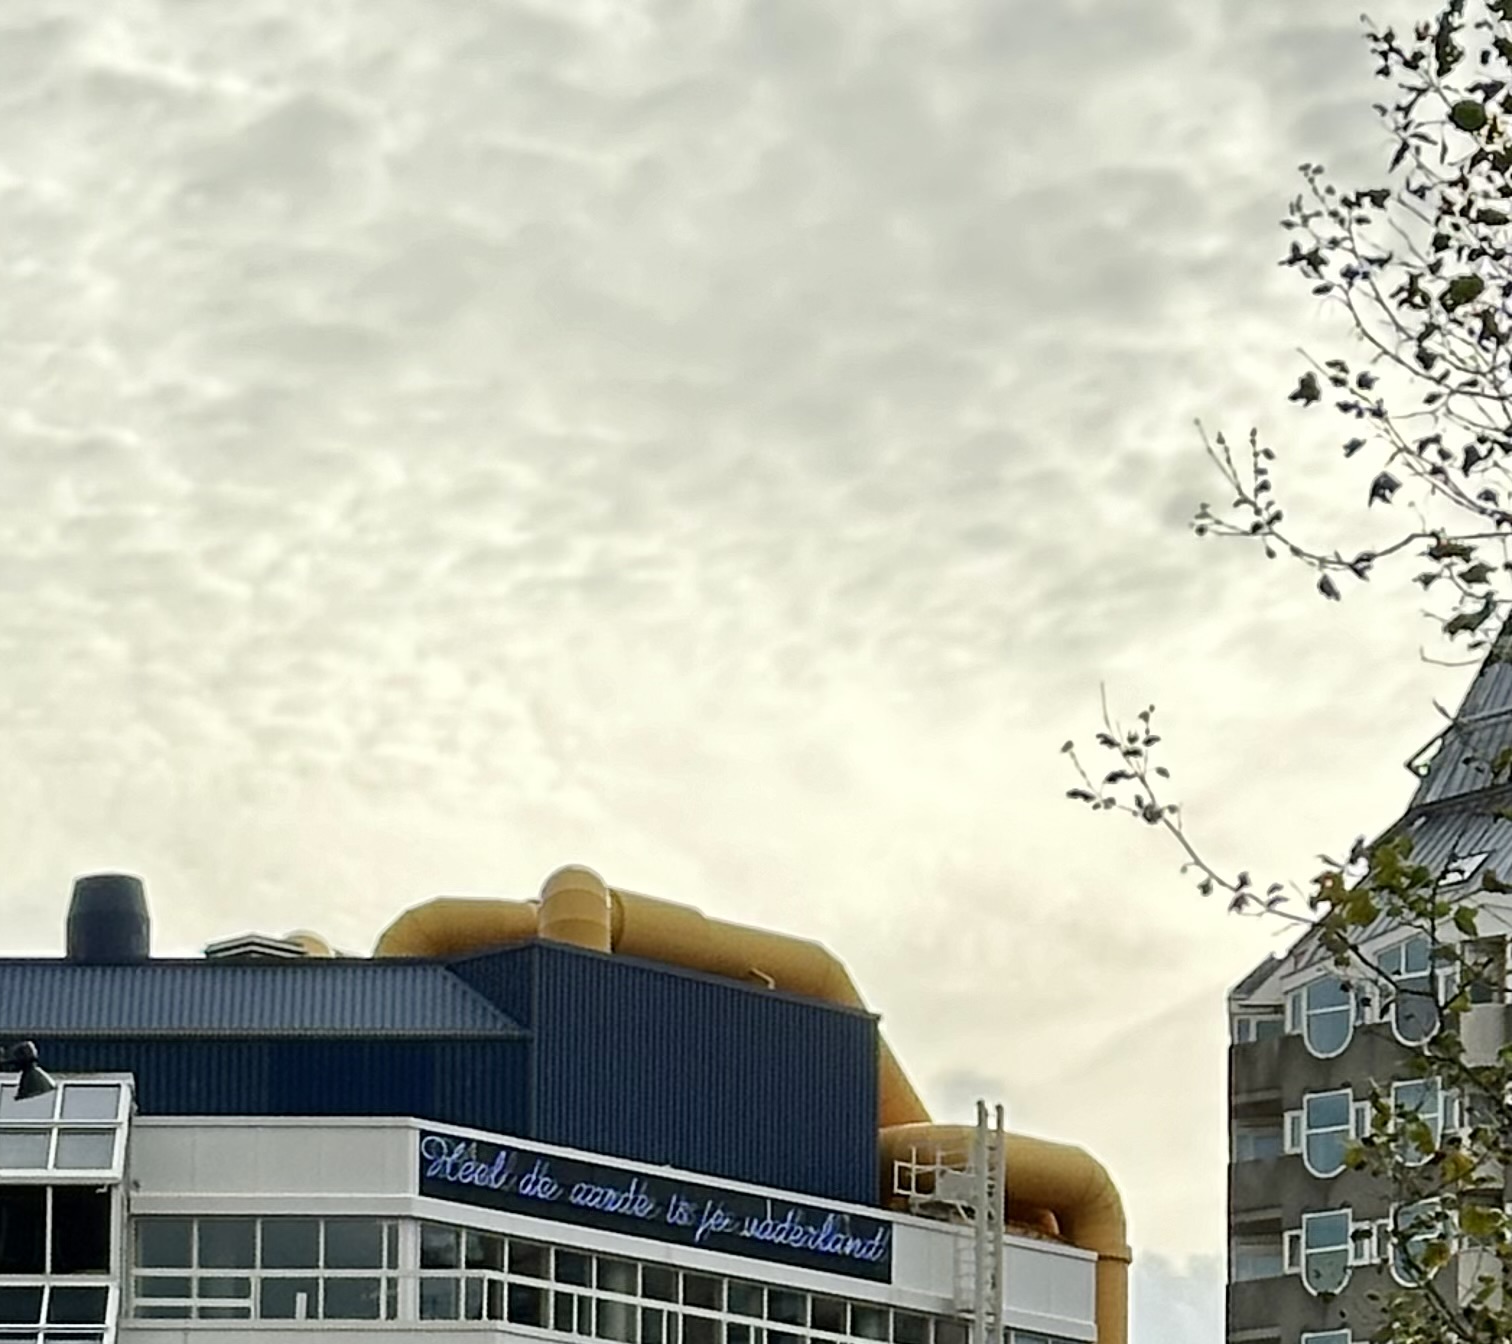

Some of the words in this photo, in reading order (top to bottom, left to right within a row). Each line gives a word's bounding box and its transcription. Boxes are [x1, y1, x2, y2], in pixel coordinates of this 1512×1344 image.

[422, 1136, 511, 1190] Heel
[519, 1158, 561, 1200] de
[569, 1177, 653, 1220] aarde
[666, 1194, 690, 1225] is
[694, 1199, 733, 1242] je
[740, 1201, 887, 1262] vaderland
